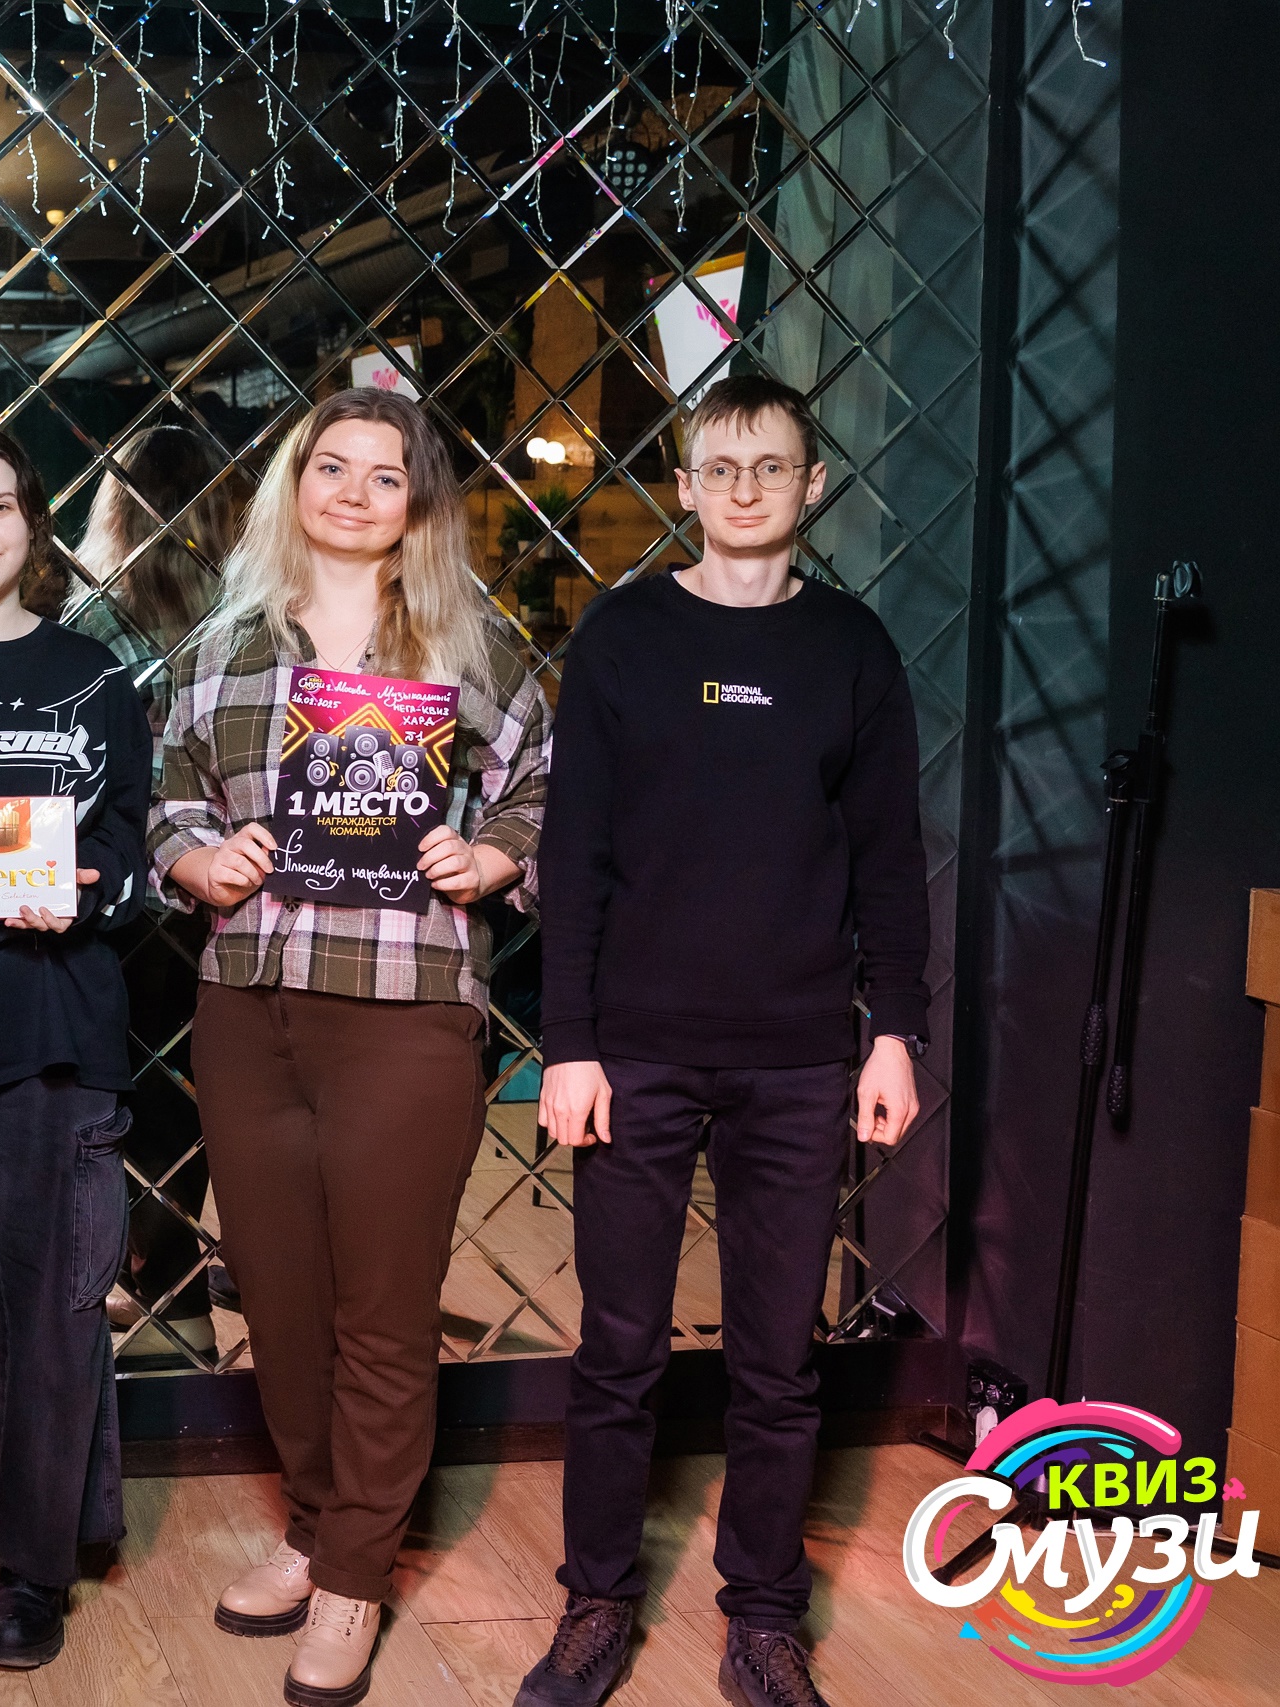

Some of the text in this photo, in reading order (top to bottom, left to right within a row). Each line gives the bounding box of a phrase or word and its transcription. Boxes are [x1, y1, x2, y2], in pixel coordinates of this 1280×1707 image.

[334, 681, 372, 696] Москва
[721, 684, 762, 696] NATIONAL
[377, 685, 452, 707] Музыкальный
[720, 693, 773, 705] GEOGRAPHIC
[402, 715, 436, 726] ХАРД
[288, 791, 430, 816] 1 МЕСТО
[317, 817, 397, 827] НАГРАЖДАЕТСЯ
[329, 827, 381, 836] КОМАНДА
[274, 829, 419, 900] Плюшевая наковальня
